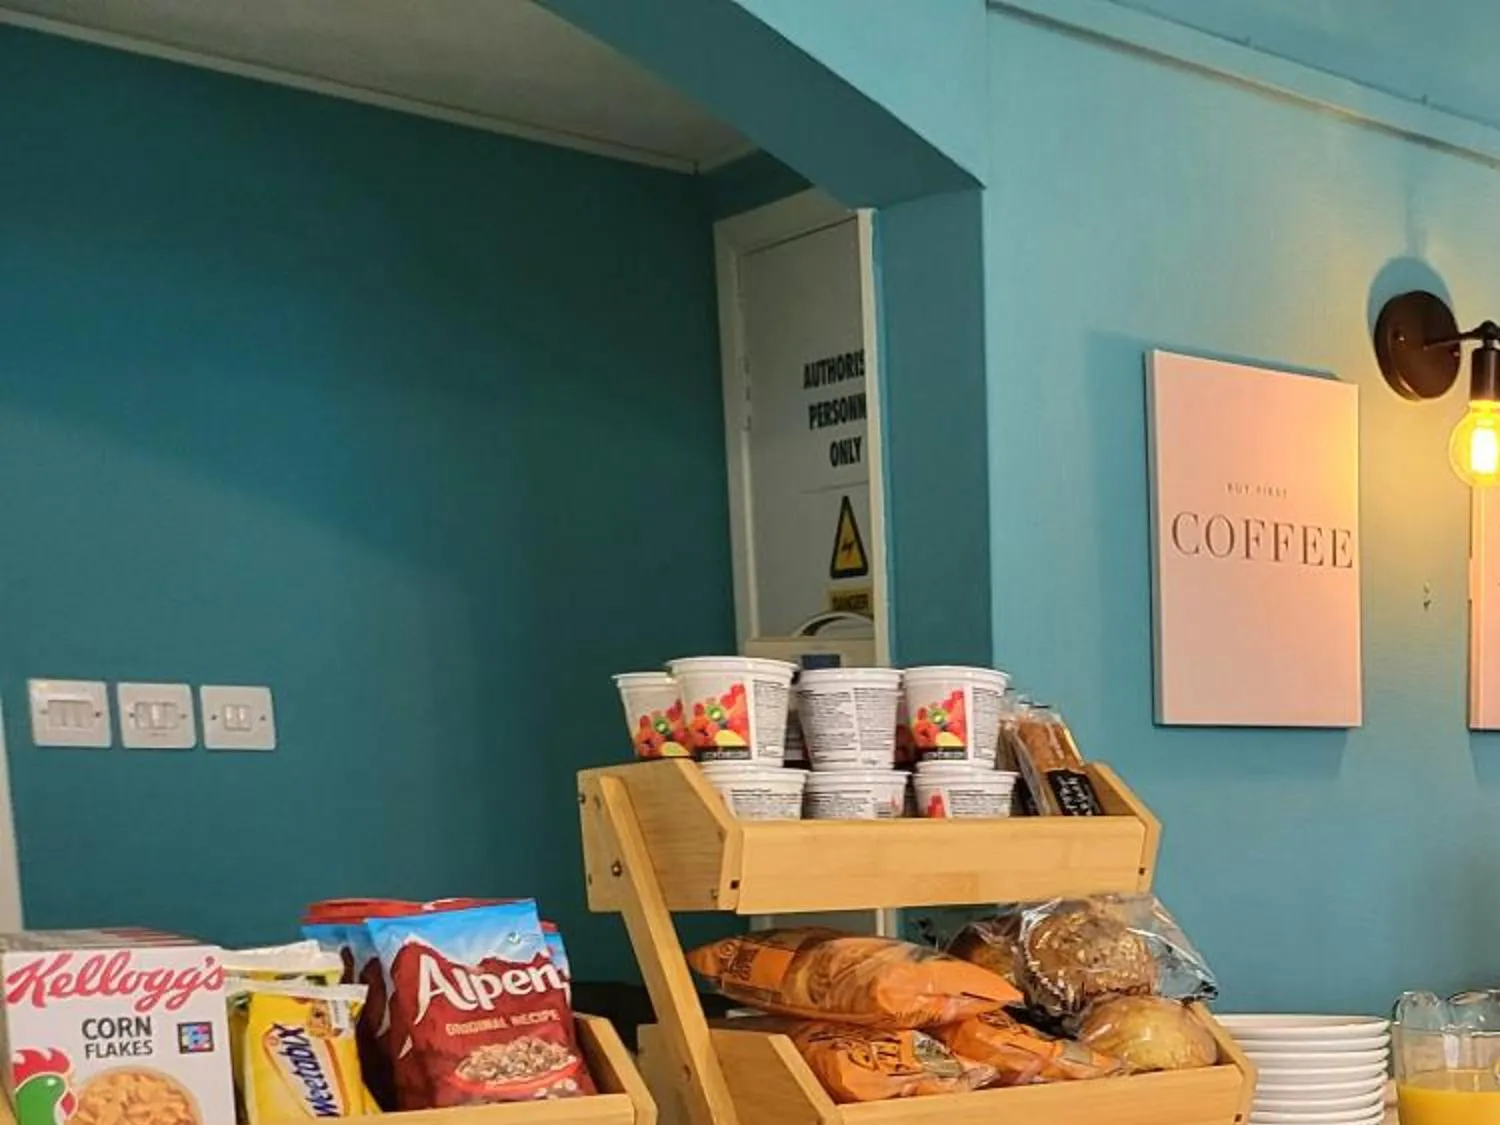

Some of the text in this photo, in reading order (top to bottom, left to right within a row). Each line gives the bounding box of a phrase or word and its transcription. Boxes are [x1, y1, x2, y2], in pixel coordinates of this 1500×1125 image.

[803, 350, 865, 388] AUTHORIS
[808, 393, 867, 429] PERSONN
[830, 436, 861, 467] ONLY
[1171, 510, 1354, 569] COFFEE
[6, 950, 226, 1012] Kellogg's
[414, 953, 568, 1025] Alpen
[81, 1015, 153, 1040] CORN
[85, 1040, 153, 1059] FLAKES
[272, 1023, 342, 1118] Weetabix
